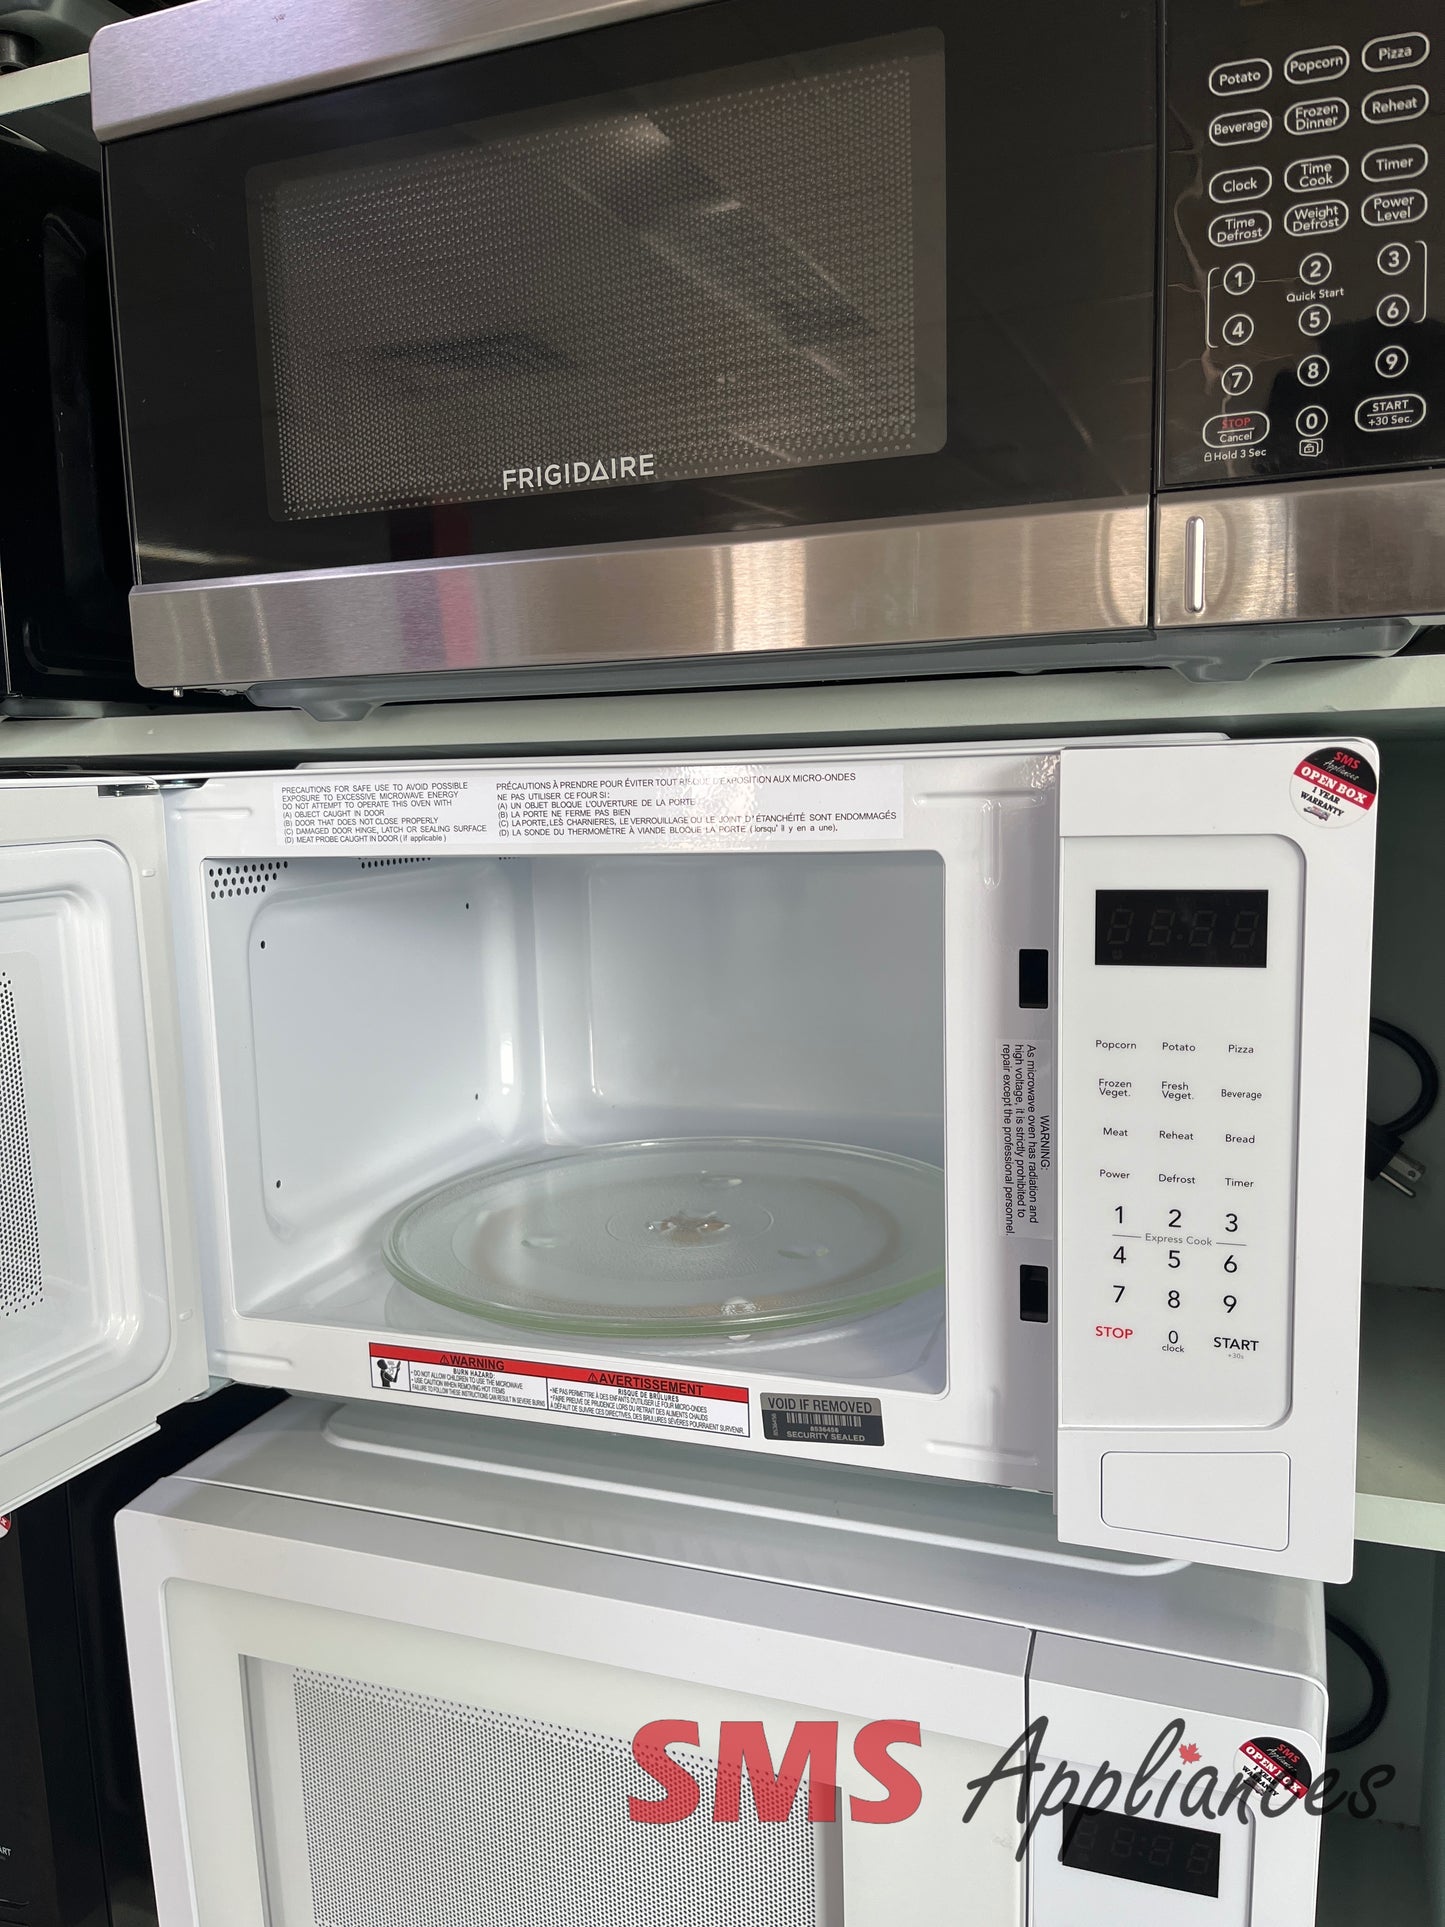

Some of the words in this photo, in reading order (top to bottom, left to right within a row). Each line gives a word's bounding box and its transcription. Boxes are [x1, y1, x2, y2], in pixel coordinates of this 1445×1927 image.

[1378, 46, 1412, 61] Pizza
[1290, 56, 1343, 74] Popcorn
[1220, 73, 1261, 85] Potato
[1295, 105, 1338, 118] Frozen
[1373, 98, 1417, 114] Reheat
[1215, 119, 1268, 135] Beverage
[1296, 116, 1338, 131] Dinner
[1301, 163, 1332, 175] Time
[1376, 158, 1413, 171] Timer
[1223, 178, 1257, 192] Clock
[1300, 174, 1333, 187] Cook
[1374, 196, 1414, 209] Power
[1295, 207, 1338, 220] Weight
[1377, 208, 1411, 221] Level
[1226, 218, 1255, 230] Time
[1293, 218, 1339, 231] Defrost
[1217, 228, 1262, 242] Defrost
[1389, 251, 1399, 267] 3
[1310, 261, 1321, 277] 2
[1235, 271, 1242, 287] 1
[1287, 291, 1316, 302] Quick
[1319, 288, 1344, 299] Start
[1387, 302, 1399, 318] 6
[1309, 312, 1319, 328] 5
[1233, 322, 1244, 338] 4
[1386, 354, 1398, 369] 9
[1308, 363, 1318, 379] 8
[1232, 372, 1243, 388] 7
[1372, 401, 1409, 411] START
[1222, 418, 1251, 428] STOP
[1306, 414, 1317, 429] 0
[1368, 416, 1388, 426] +30
[1391, 415, 1412, 424] Sec.
[1219, 432, 1252, 442] Cancel
[1214, 451, 1237, 460] Hold
[1240, 450, 1245, 458] 3
[1248, 449, 1266, 457] Sec
[503, 454, 654, 490] FRIGIDAIRE
[1334, 751, 1360, 769] SMS
[1323, 760, 1359, 781] Appliances
[1301, 766, 1337, 789] OPEN
[1336, 783, 1367, 804] BOX
[282, 794, 320, 802] EXPOSURE
[336, 793, 376, 801] EXCESSIVE
[1300, 791, 1344, 816] WARRANTY
[1319, 790, 1340, 804] YEAR
[283, 811, 292, 819] (A)
[498, 811, 508, 819] (B)
[1027, 1044, 1036, 1057] As
[1095, 1040, 1136, 1050] Popcorn
[1162, 1042, 1196, 1051] Potato
[1228, 1045, 1254, 1053] Pizza
[1001, 1044, 1011, 1072] repair
[1013, 1044, 1023, 1065] high
[1014, 1068, 1024, 1105] voltage,
[1027, 1061, 1036, 1112] microwave
[1099, 1079, 1132, 1087] Frozen
[1162, 1082, 1188, 1090] Fresh
[1002, 1075, 1011, 1106] except
[1099, 1088, 1130, 1098] Veget.
[1162, 1091, 1194, 1101] Veget.
[1221, 1089, 1262, 1100] Beverage
[1004, 1109, 1012, 1124] the
[1016, 1116, 1024, 1124] is
[1103, 1128, 1128, 1136] Meat
[1159, 1131, 1194, 1140] Reheat
[1226, 1135, 1255, 1143] Bread
[1014, 1127, 1025, 1157] strictly
[1041, 1115, 1050, 1171] WARNING:
[1003, 1127, 1013, 1184] professional
[1029, 1142, 1037, 1159] has
[1100, 1170, 1130, 1179] Power
[1159, 1174, 1195, 1184] Defrost
[1015, 1160, 1026, 1206] prohibited
[1029, 1162, 1038, 1203] radiation
[1225, 1178, 1254, 1187] Timer
[1003, 1187, 1014, 1236] personnel.
[1017, 1209, 1025, 1217] to
[1029, 1205, 1038, 1223] and
[1115, 1206, 1123, 1223] 1
[1169, 1209, 1181, 1227] 2
[1225, 1213, 1238, 1232] 3
[1146, 1233, 1183, 1243] Express
[1186, 1236, 1212, 1245] Cook
[1113, 1246, 1126, 1263] 4
[1168, 1250, 1180, 1268] 5
[1224, 1255, 1237, 1273] 6
[1113, 1285, 1125, 1303] 7
[1168, 1290, 1180, 1308] 8
[1223, 1295, 1237, 1313] 9
[1095, 1326, 1133, 1339] STOP
[1169, 1330, 1178, 1344] 0
[1214, 1337, 1259, 1351] START
[450, 1356, 504, 1370] WARNING
[470, 1370, 495, 1378] HAZARD:
[600, 1374, 703, 1395] AVERTISSEMENT
[618, 1389, 638, 1397] RISQUE
[649, 1392, 679, 1402] BRÛLURES
[768, 1397, 796, 1409] VOID
[800, 1399, 809, 1410] IF
[814, 1400, 872, 1413] REMOVED
[786, 1431, 828, 1439] SECURITY
[831, 1433, 865, 1441] SEALED
[1246, 1746, 1277, 1773] OPEN
[1277, 1744, 1300, 1763] SMS
